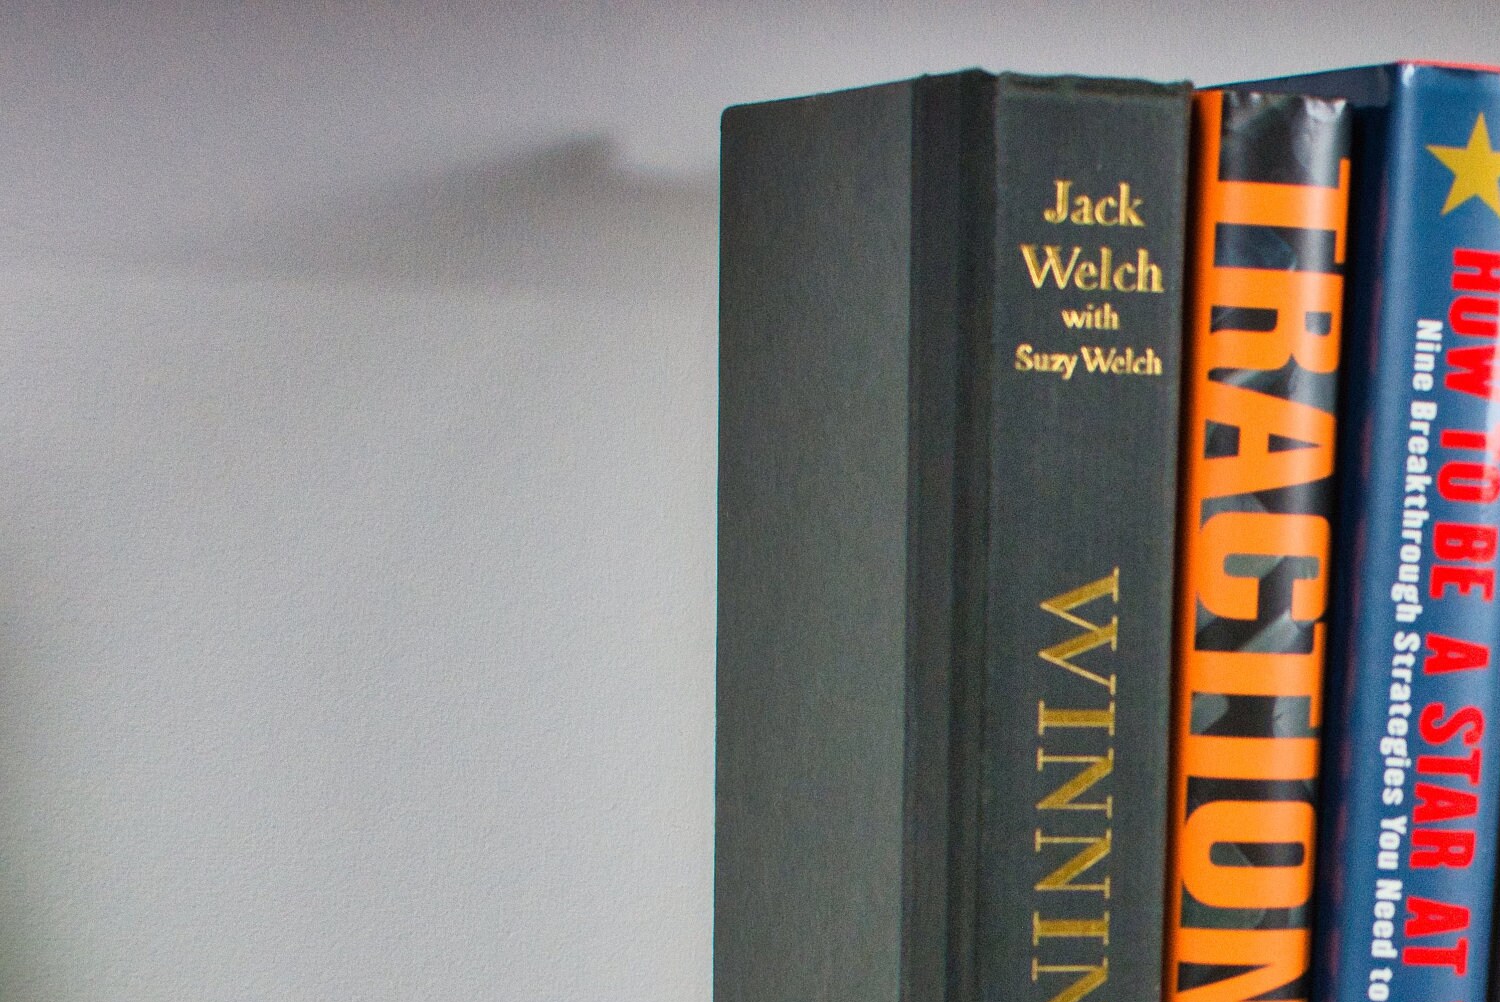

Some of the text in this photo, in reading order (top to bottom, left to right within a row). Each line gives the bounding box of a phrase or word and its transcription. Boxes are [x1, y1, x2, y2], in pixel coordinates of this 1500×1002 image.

[1044, 179, 1146, 227] Jack
[1020, 243, 1164, 293] Welch
[1061, 303, 1120, 330] with
[1015, 344, 1163, 380] Suzy Welch
[1412, 318, 1443, 393] Nine
[1391, 400, 1437, 624] Breakthrough
[1429, 521, 1498, 603] BE
[1423, 632, 1490, 676] A
[1380, 631, 1421, 806] Strategies
[1409, 702, 1485, 869] STAR
[1377, 815, 1408, 870] You
[1371, 879, 1403, 958] Need
[1402, 896, 1471, 977] AT
[1368, 967, 1393, 1002] to
